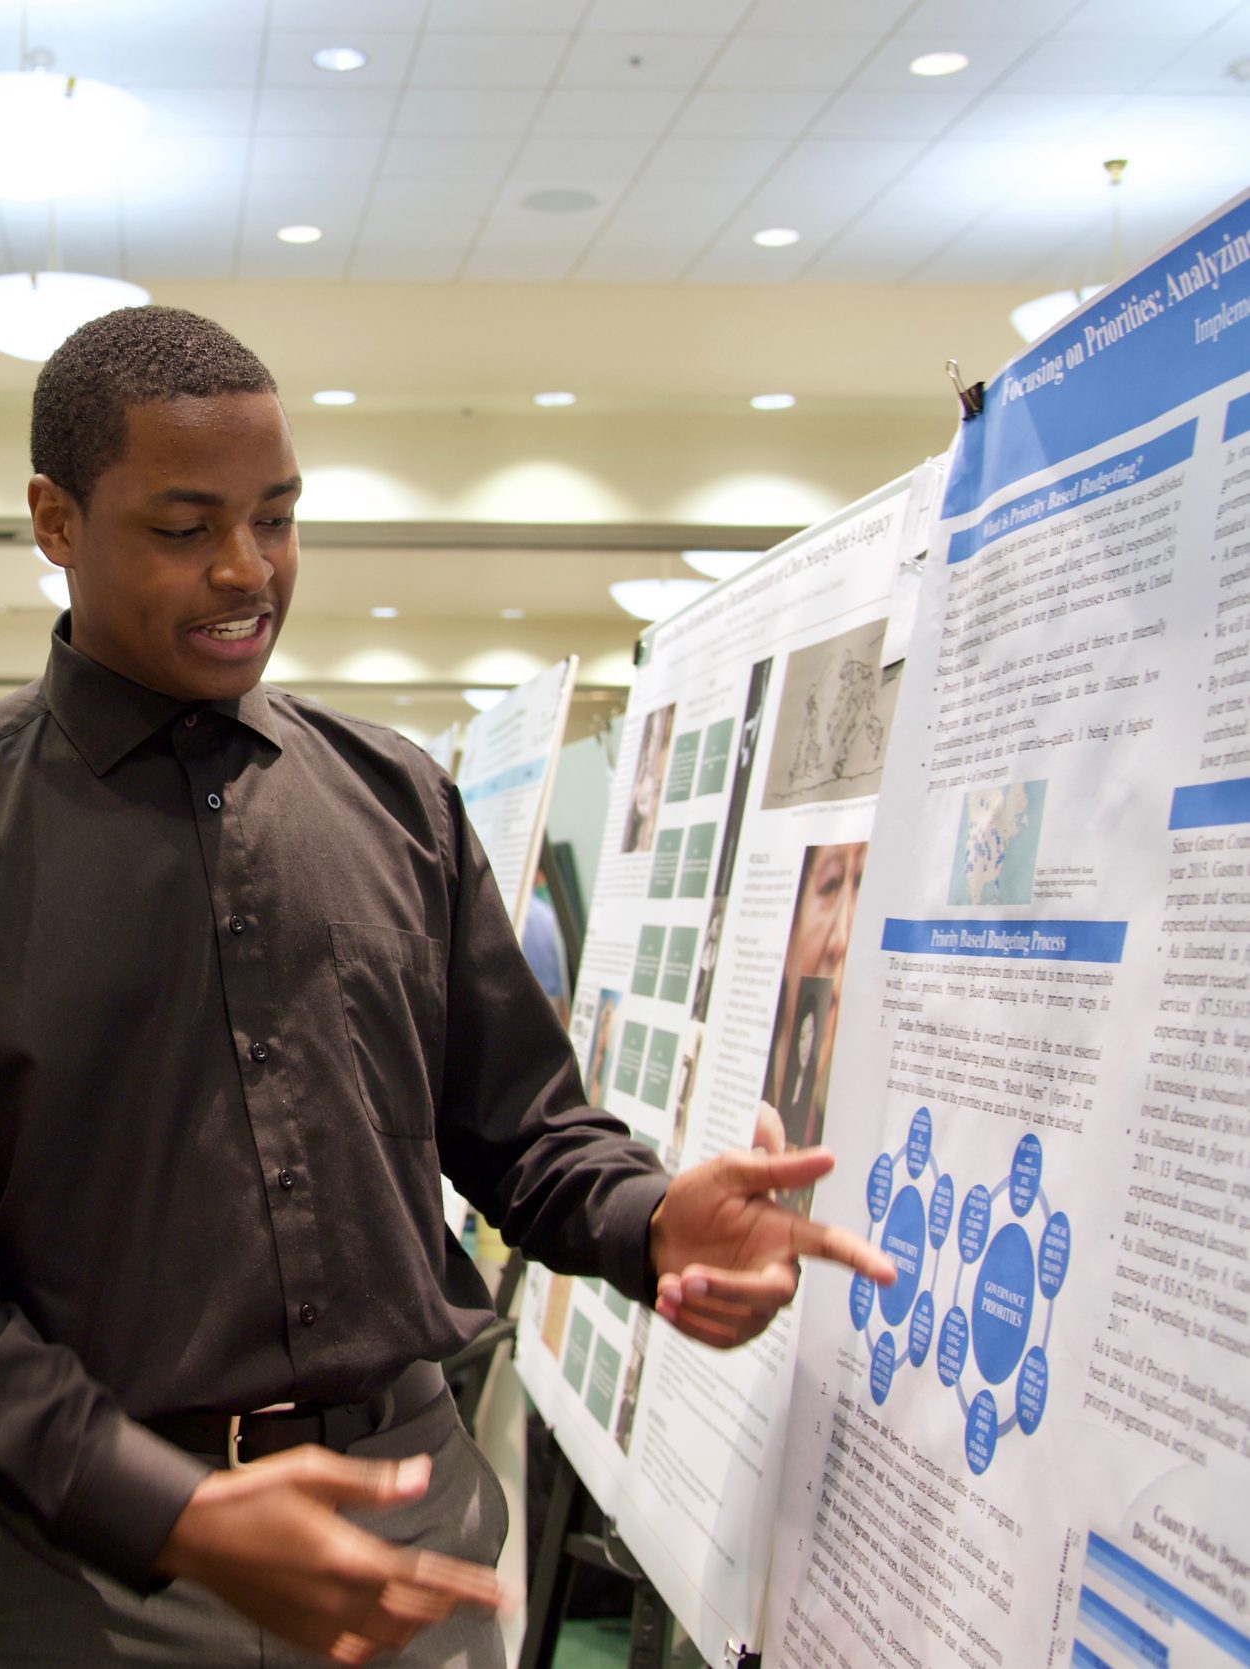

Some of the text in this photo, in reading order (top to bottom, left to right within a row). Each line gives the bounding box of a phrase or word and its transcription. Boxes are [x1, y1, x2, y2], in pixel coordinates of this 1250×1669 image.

[1002, 355, 1065, 406] Focusing
[1065, 340, 1085, 370] on
[1083, 289, 1165, 358] Priorities:
[1009, 498, 1046, 530] Priority
[1047, 482, 1079, 511] Based
[1080, 454, 1144, 499] Budgeting?
[931, 929, 1066, 956] Priority Based Budgeting Process
[984, 1281, 1026, 1309] GOVERNANCE
[981, 1297, 1023, 1328] PRIORITIES
